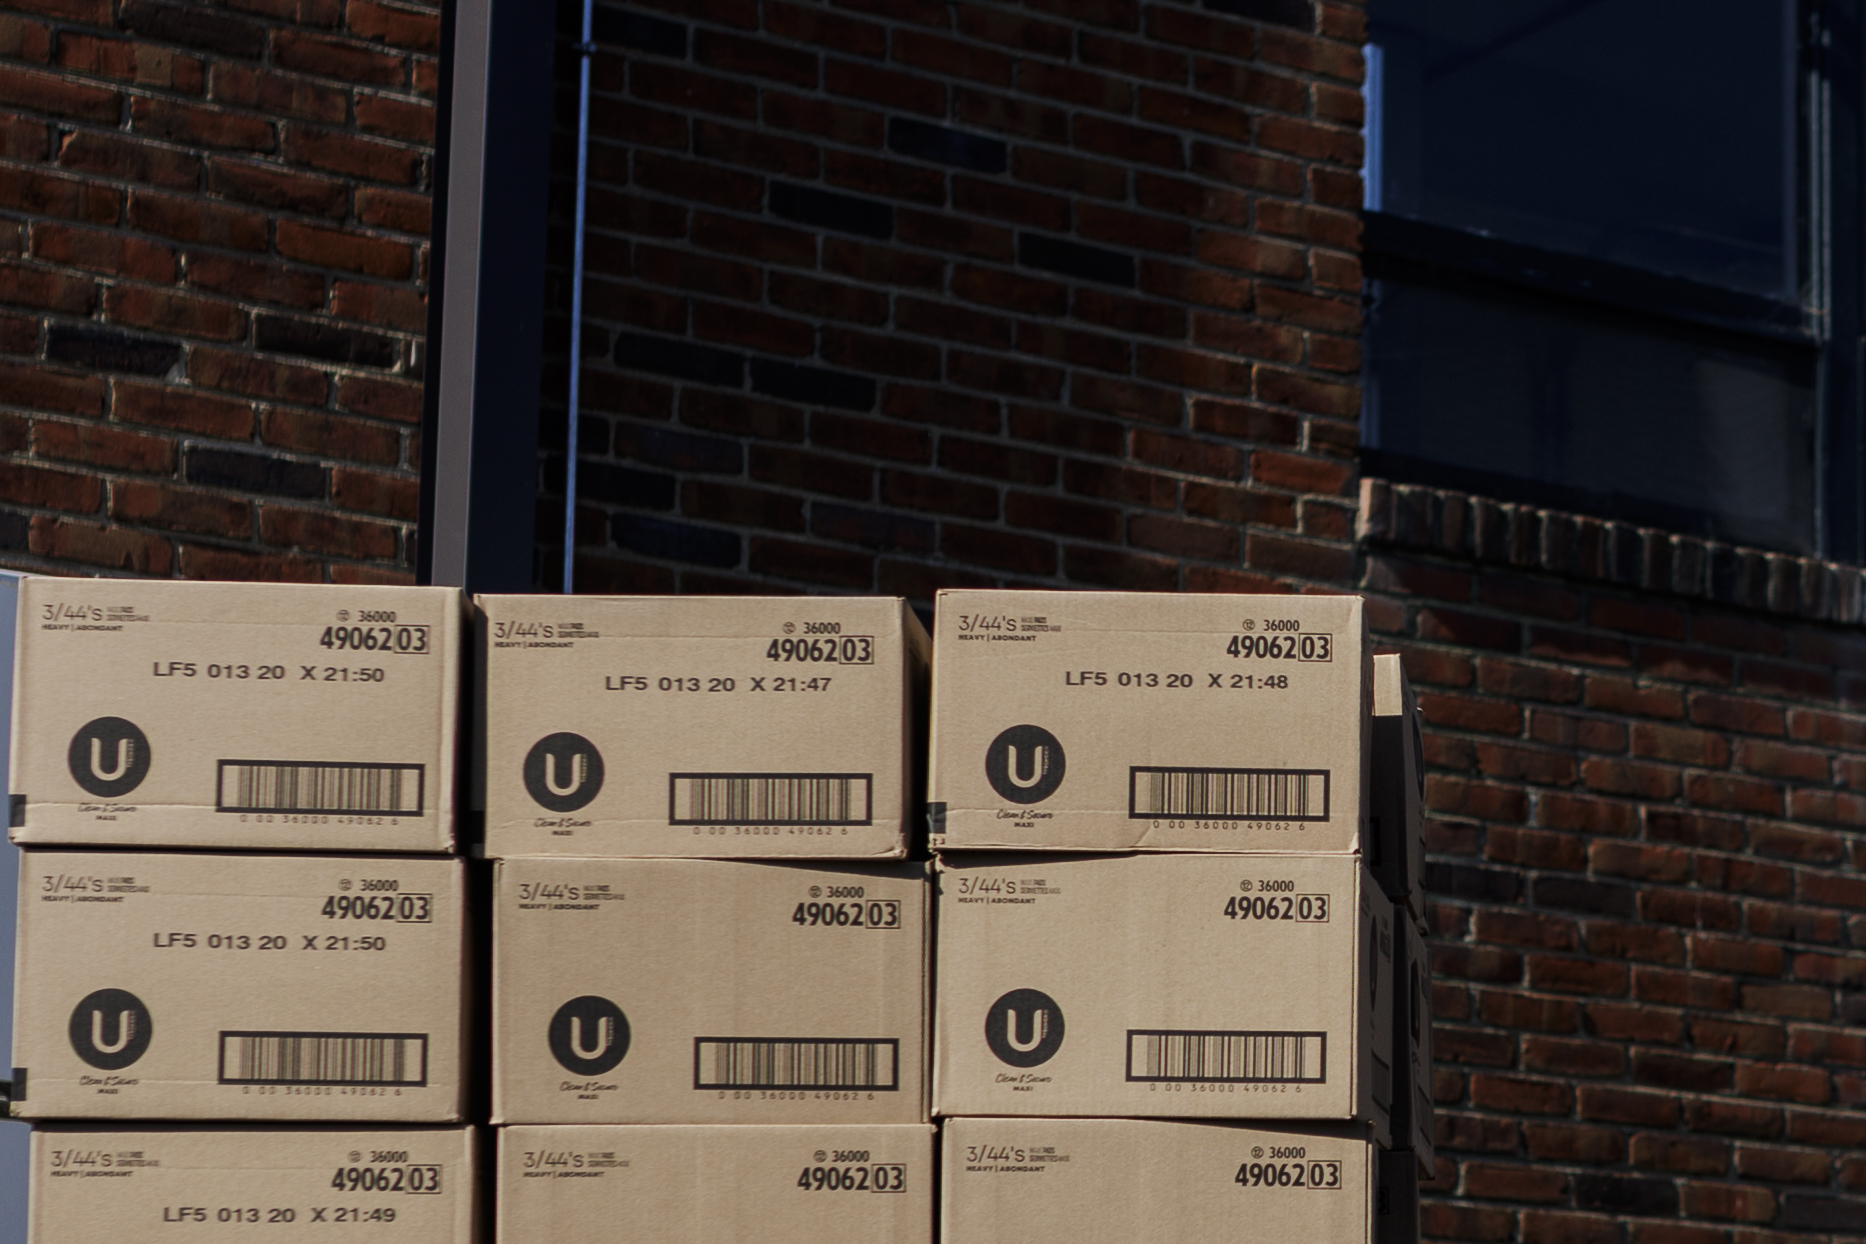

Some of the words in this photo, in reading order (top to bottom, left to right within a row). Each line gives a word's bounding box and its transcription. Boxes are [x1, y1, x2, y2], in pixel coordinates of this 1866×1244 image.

[358, 610, 396, 623] 36000
[803, 622, 841, 634] 36000
[1263, 619, 1300, 632] 36000
[154, 662, 196, 677] LF5
[207, 664, 249, 679] 013
[257, 665, 285, 680] 20
[301, 666, 316, 680] X
[324, 667, 384, 682] 21:50
[1066, 671, 1107, 686] LF5
[1118, 672, 1159, 687] 013
[1166, 674, 1193, 688] 20
[1208, 673, 1222, 688] X
[1230, 674, 1288, 689] 21:48
[606, 676, 648, 691] LF5
[659, 677, 700, 692] 013
[708, 678, 735, 692] 20
[750, 677, 765, 691] X
[773, 677, 831, 691] 21:47
[91, 737, 128, 780] U
[546, 753, 581, 796] U
[1008, 746, 1043, 788] U
[361, 879, 399, 892] 36000
[827, 886, 864, 898] 36000
[1258, 880, 1294, 892] 36000
[154, 933, 196, 947] LF5
[208, 934, 250, 950] 013
[259, 936, 286, 950] 20
[302, 936, 318, 950] X
[325, 936, 386, 951] 21:50
[93, 1010, 129, 1053] U
[571, 1016, 607, 1059] U
[1007, 1009, 1041, 1051] U
[370, 1151, 408, 1163] 36000
[832, 1150, 870, 1163] 36000
[1269, 1146, 1306, 1159] 36000
[164, 1207, 206, 1222] LF5
[218, 1208, 259, 1223] 013
[268, 1208, 295, 1223] 20
[311, 1207, 327, 1222] X
[334, 1207, 396, 1223] 21:49
